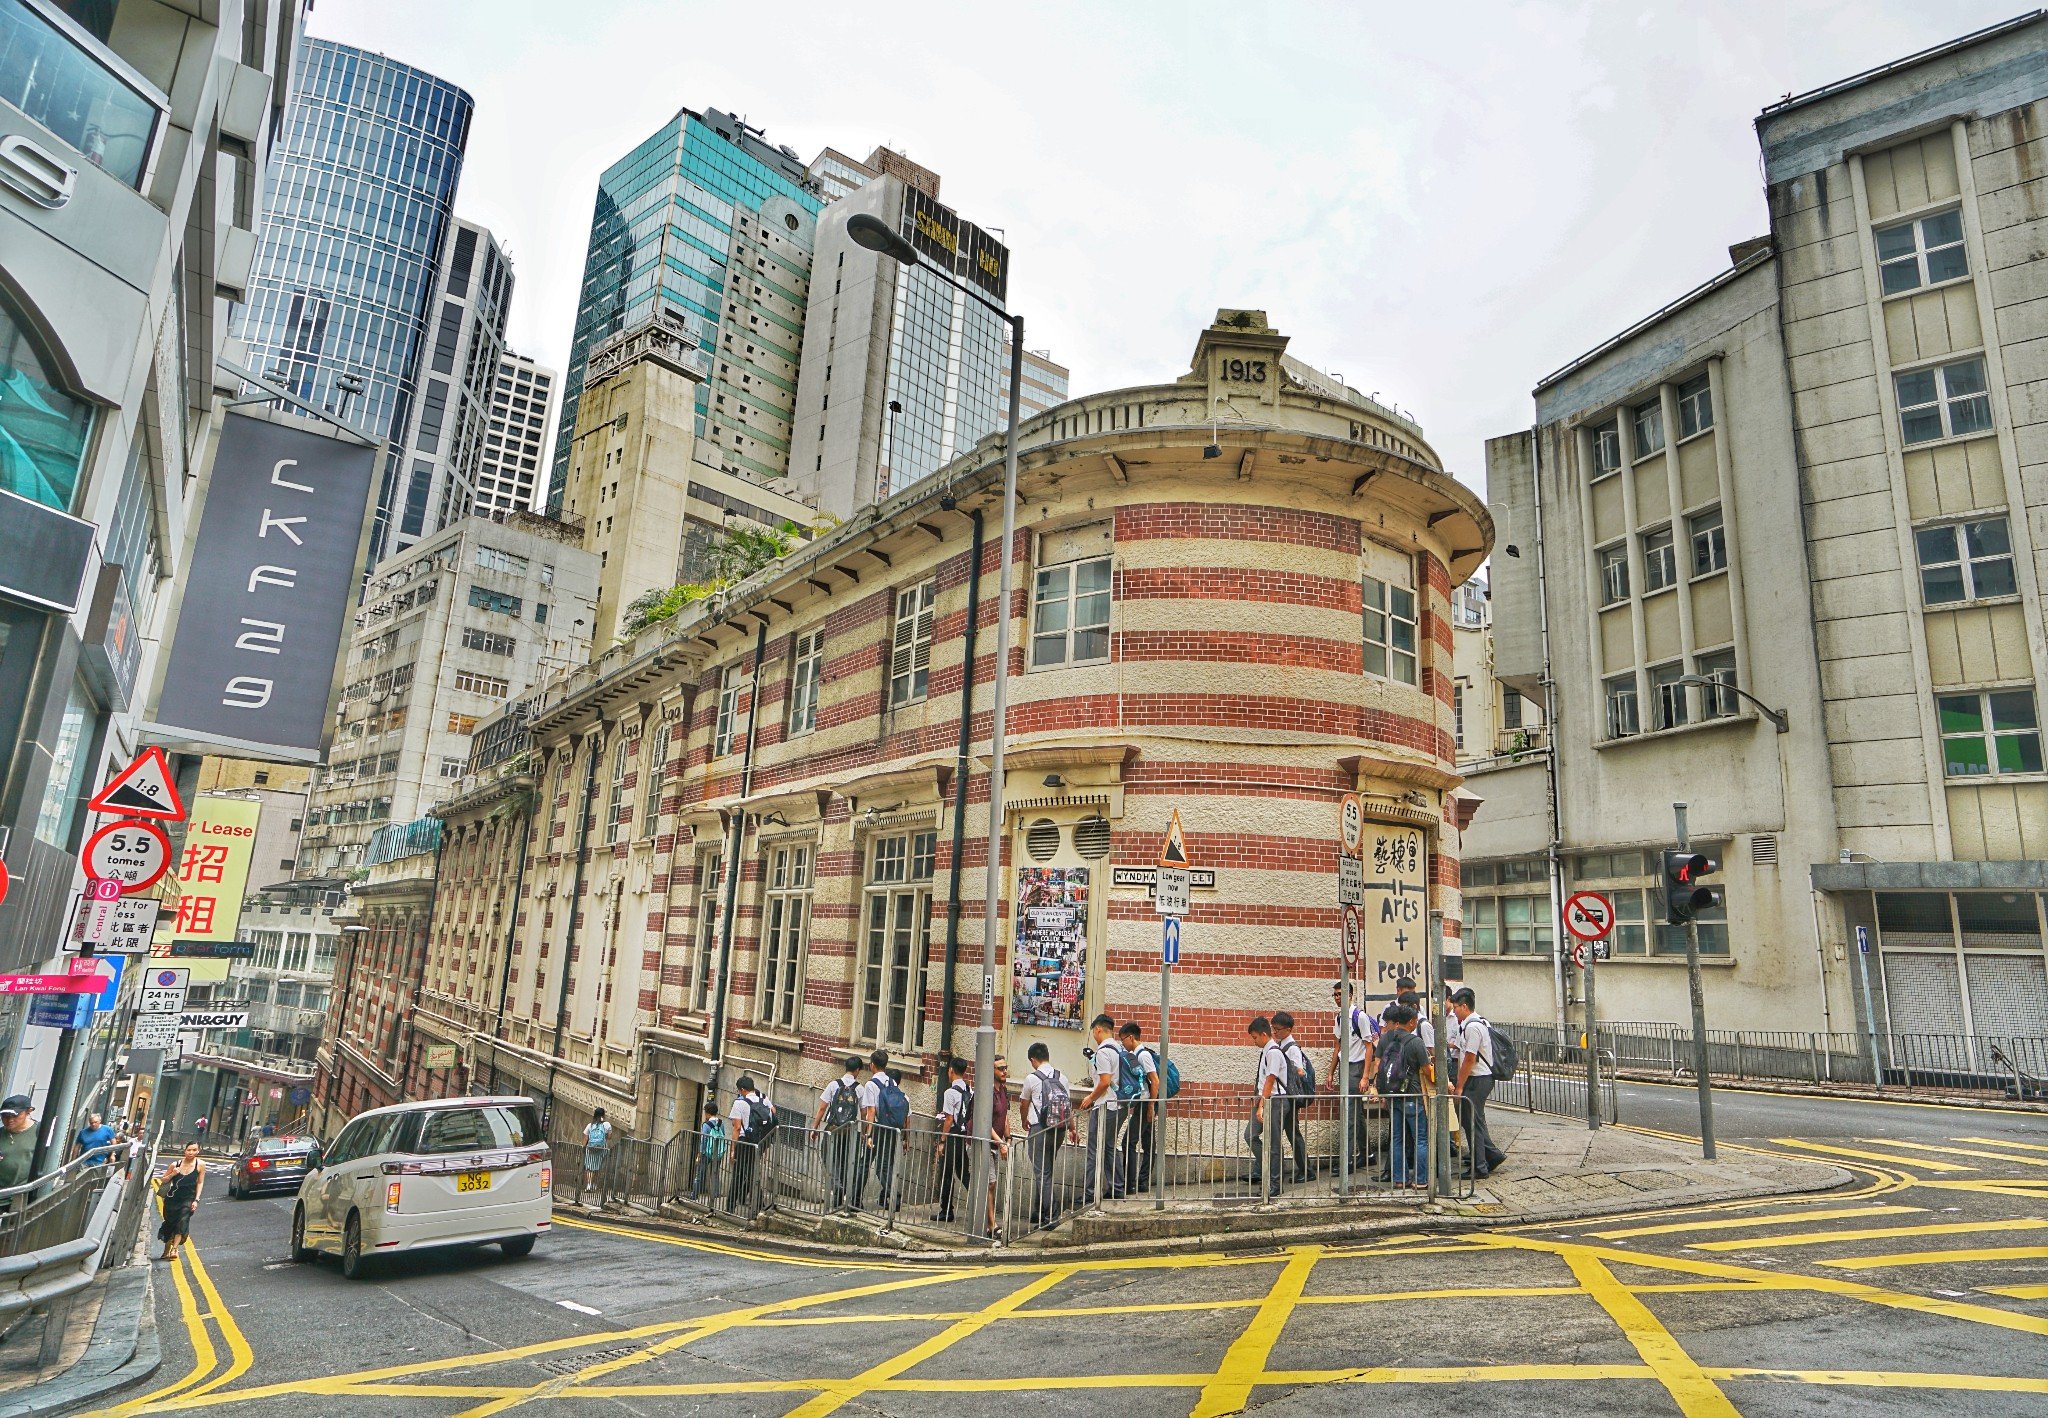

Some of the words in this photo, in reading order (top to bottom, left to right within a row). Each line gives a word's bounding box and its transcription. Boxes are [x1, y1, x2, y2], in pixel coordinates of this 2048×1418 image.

[1221, 359, 1266, 382] 1913
[136, 778, 160, 797] 1:8
[1346, 803, 1357, 820] 5.5
[201, 820, 253, 838] Lease
[110, 833, 151, 854] 5.5
[107, 856, 146, 867] tonnes
[1116, 871, 1156, 881] WYNDHA
[1192, 873, 1212, 883] EET
[175, 843, 229, 935] 招租
[1167, 884, 1179, 892] now
[133, 901, 149, 910] for
[1381, 897, 1418, 923] Arts
[91, 905, 108, 939] Central
[147, 991, 162, 999] 24
[164, 991, 180, 999] hrs
[149, 1000, 174, 1010] 全日
[180, 1014, 244, 1026] ONI&GUY
[467, 1173, 482, 1181] NG
[460, 1181, 489, 1191] 3032
